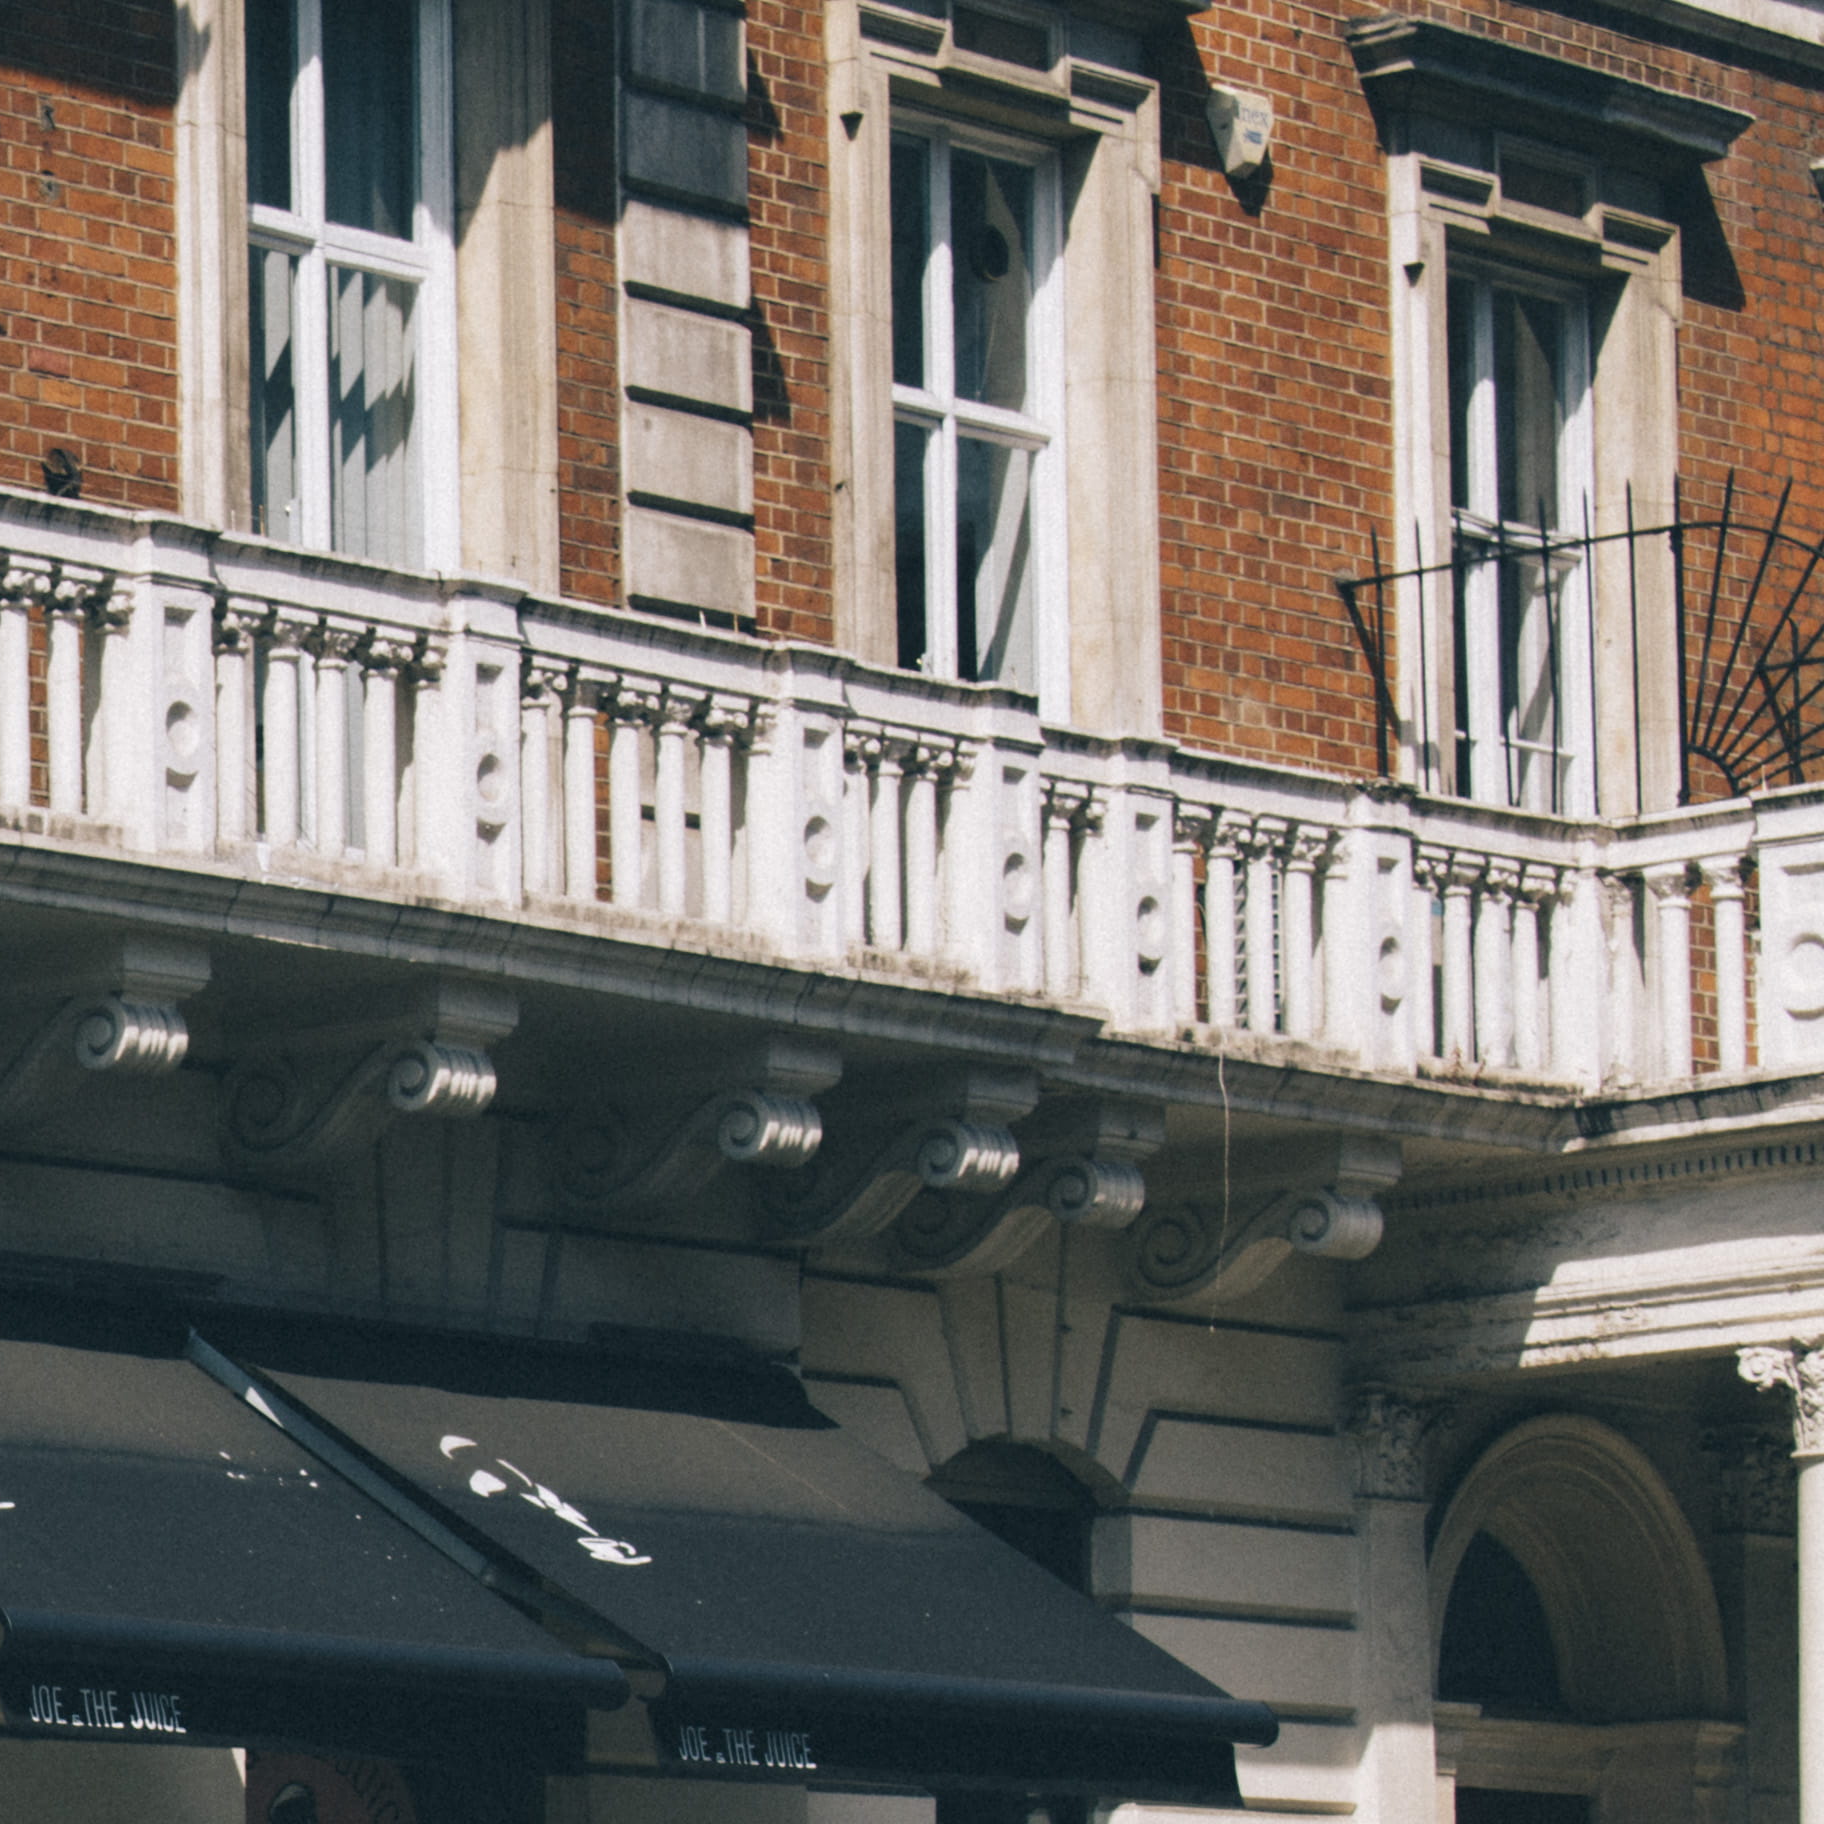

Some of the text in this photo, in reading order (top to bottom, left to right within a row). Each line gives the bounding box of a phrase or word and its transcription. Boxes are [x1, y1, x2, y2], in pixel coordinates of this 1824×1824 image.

[29, 1684, 68, 1725] JOE
[80, 1688, 124, 1729] THE
[130, 1690, 187, 1734] JUICE
[679, 1726, 712, 1761] JOE
[723, 1728, 760, 1765] THE
[764, 1730, 817, 1769] JUICE
